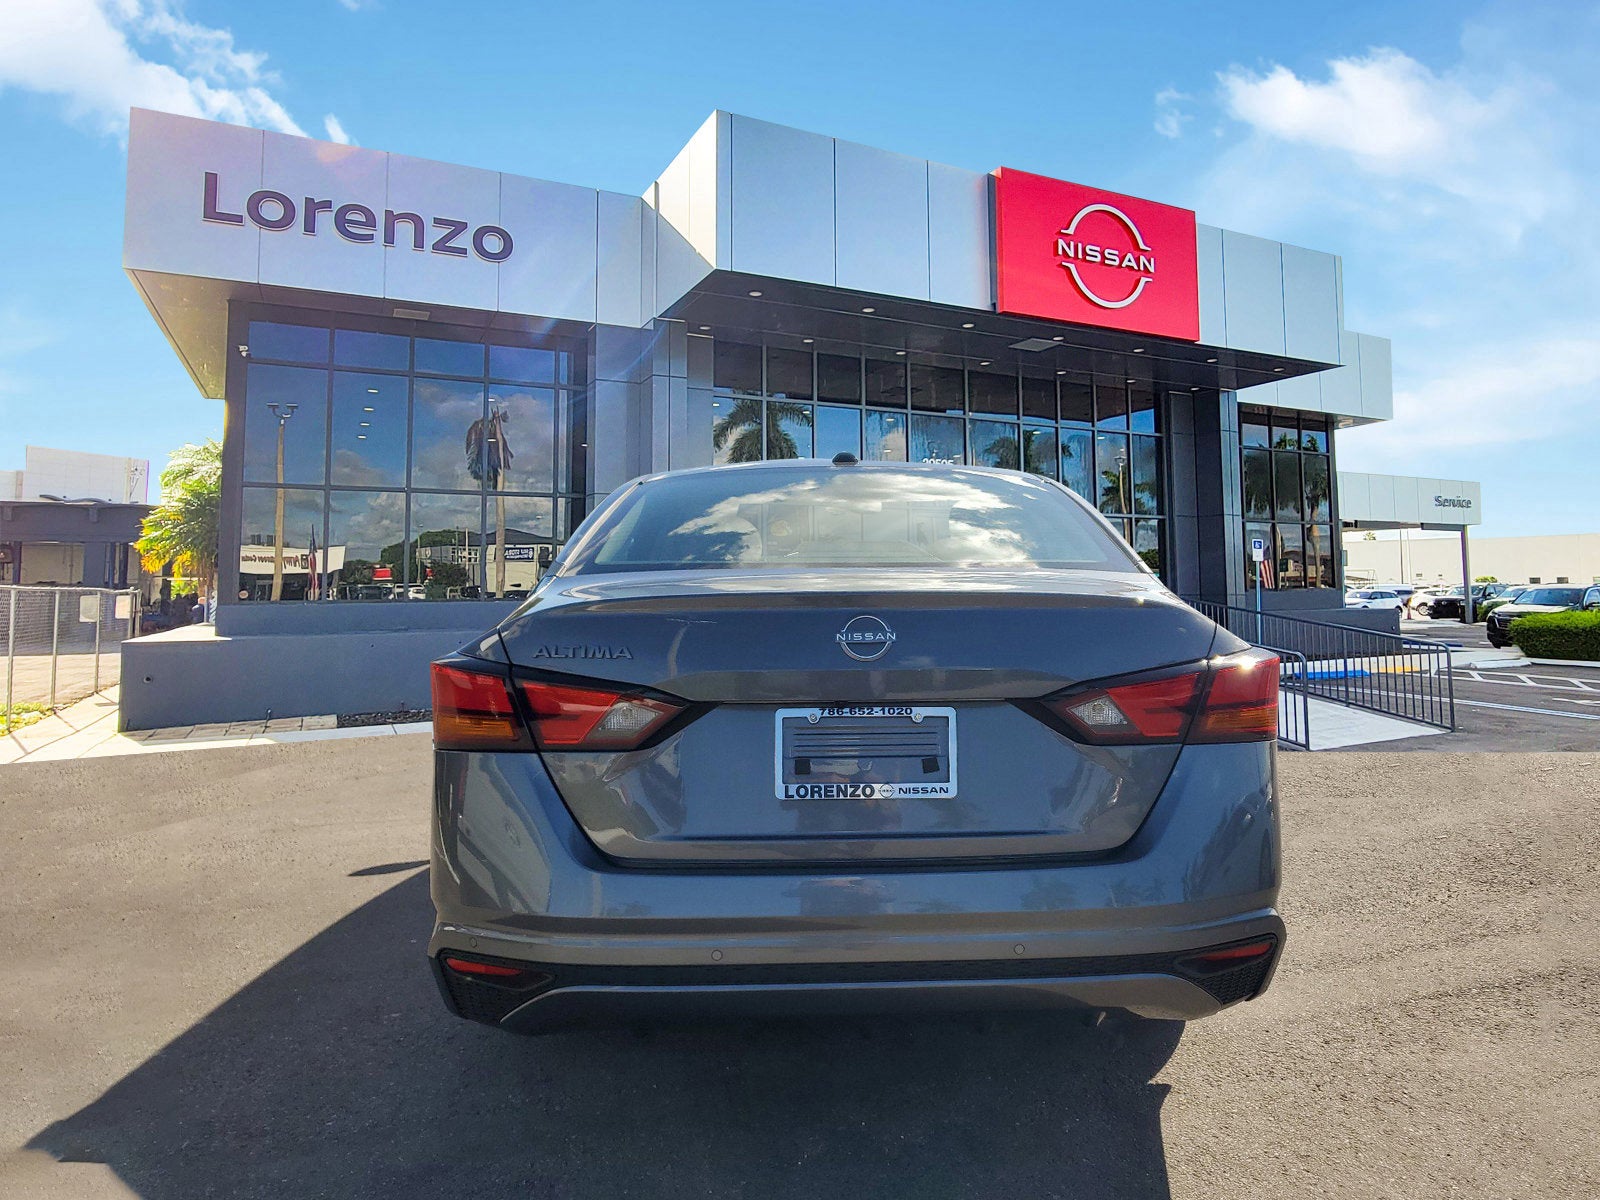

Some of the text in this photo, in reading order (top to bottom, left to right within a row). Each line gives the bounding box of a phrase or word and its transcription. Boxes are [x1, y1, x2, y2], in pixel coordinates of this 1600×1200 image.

[202, 171, 514, 262] Lorenzo
[1057, 238, 1155, 273] NISSAN
[1434, 495, 1472, 508] Service
[836, 632, 896, 641] NISSAN
[532, 645, 634, 659] ALTIMA
[818, 707, 913, 716] 786-652-1020
[784, 784, 875, 799] LORENZO
[898, 786, 949, 795] NISSAN
